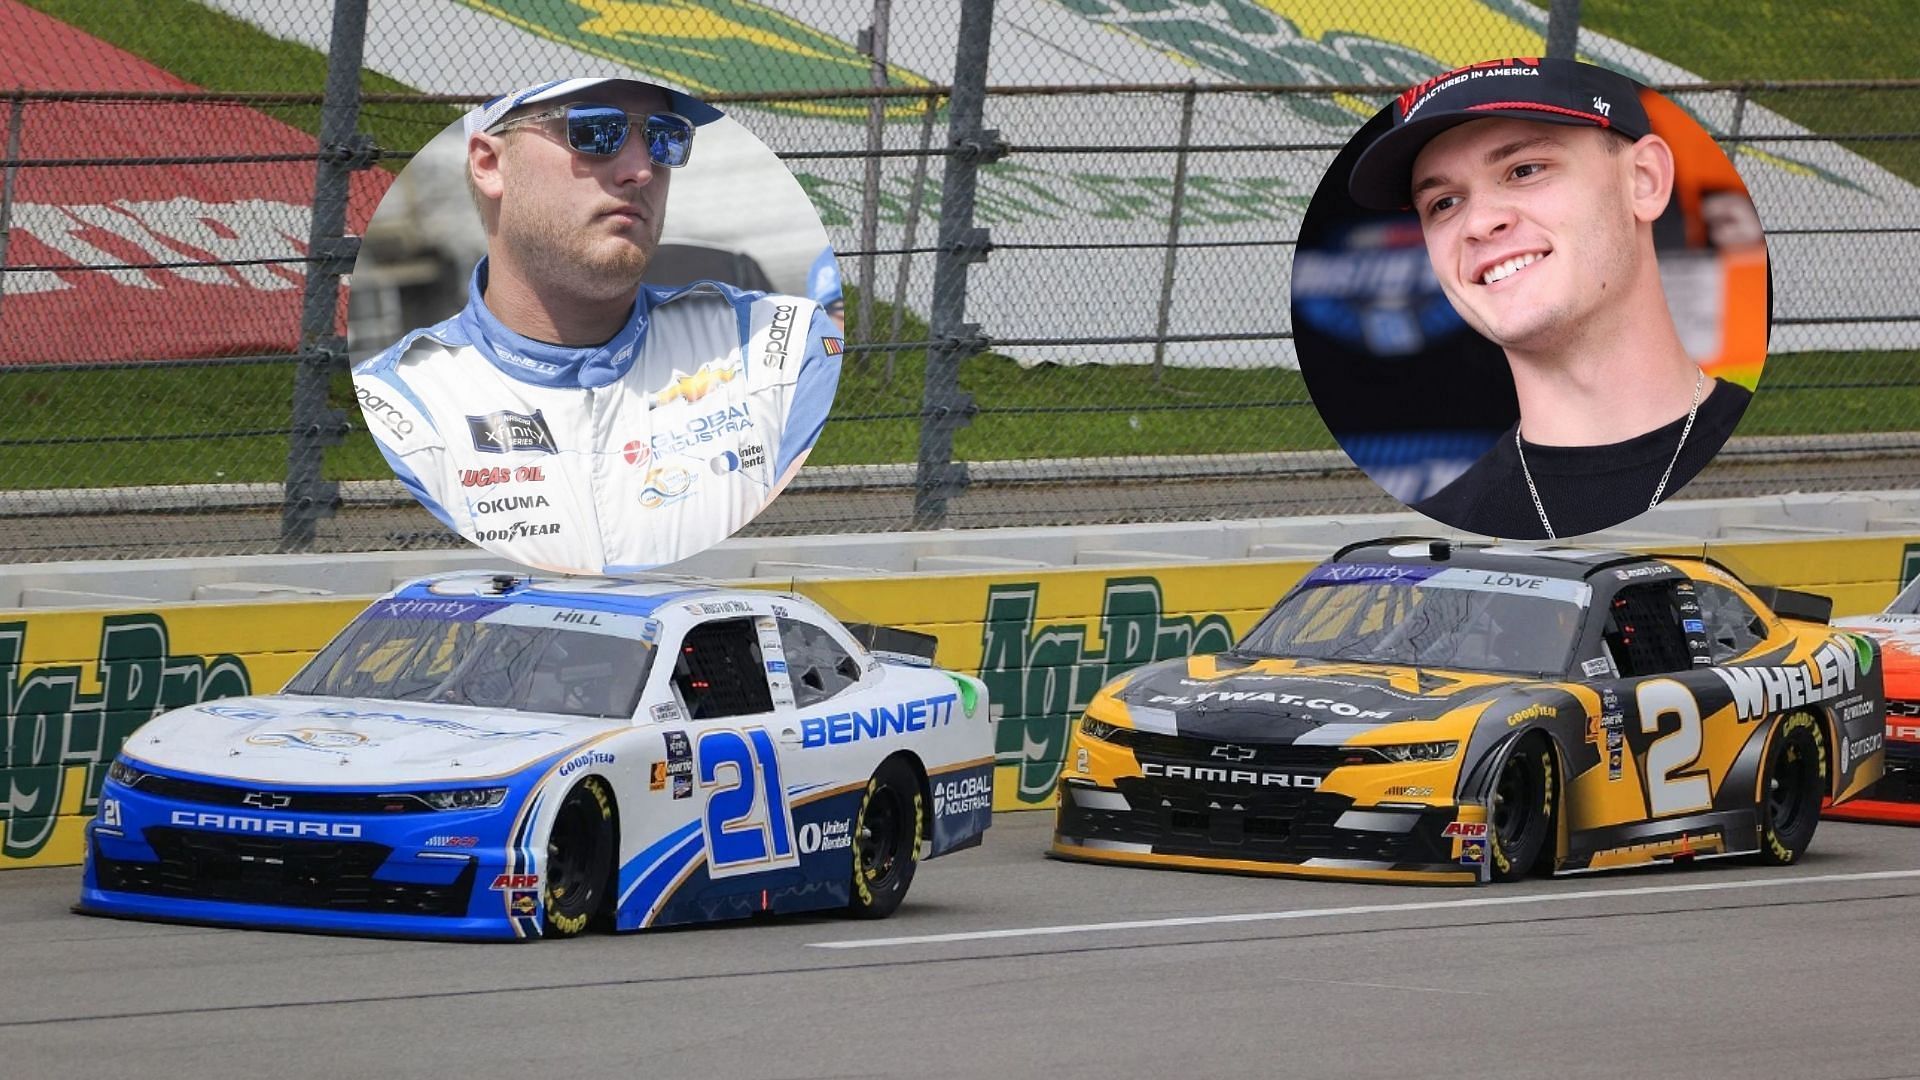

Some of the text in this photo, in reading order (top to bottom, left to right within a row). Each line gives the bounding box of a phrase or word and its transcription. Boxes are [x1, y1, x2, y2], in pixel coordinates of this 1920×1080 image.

[1403, 68, 1540, 123] MANUFACTURED IN AMERICA
[763, 304, 795, 369] sparco
[503, 415, 531, 426] NASCAR
[485, 422, 545, 445] xfinity
[507, 438, 534, 446] SERIES
[654, 419, 754, 460] INDUSTRIA
[515, 466, 545, 482] OIL
[741, 455, 766, 470] enta
[477, 495, 550, 514] OKUMA
[475, 521, 561, 542] OODYEAR
[1324, 563, 1416, 582] xfinity
[1483, 574, 1544, 590] LOVE
[383, 599, 478, 617] xfinity
[553, 610, 603, 626] HILL
[984, 577, 1233, 803] Ag-P
[1711, 634, 1858, 724] WHELEN
[799, 693, 958, 748] BENNETT
[1507, 703, 1558, 727] GOODYEAR
[0, 612, 252, 858] g-P
[1636, 678, 1713, 819] 2
[559, 750, 616, 777] GOODYEAR
[1076, 748, 1089, 774] 2
[945, 775, 991, 800] GLOBAL
[1141, 763, 1325, 790] CAMARO
[104, 799, 121, 827] 21
[697, 725, 800, 879] 21
[945, 797, 991, 816] INDUSTRIAL
[171, 810, 361, 838] CAMARO
[822, 818, 852, 835] United
[1444, 823, 1487, 836] ARP
[821, 834, 852, 852] Rentals
[492, 875, 540, 888] ARP
